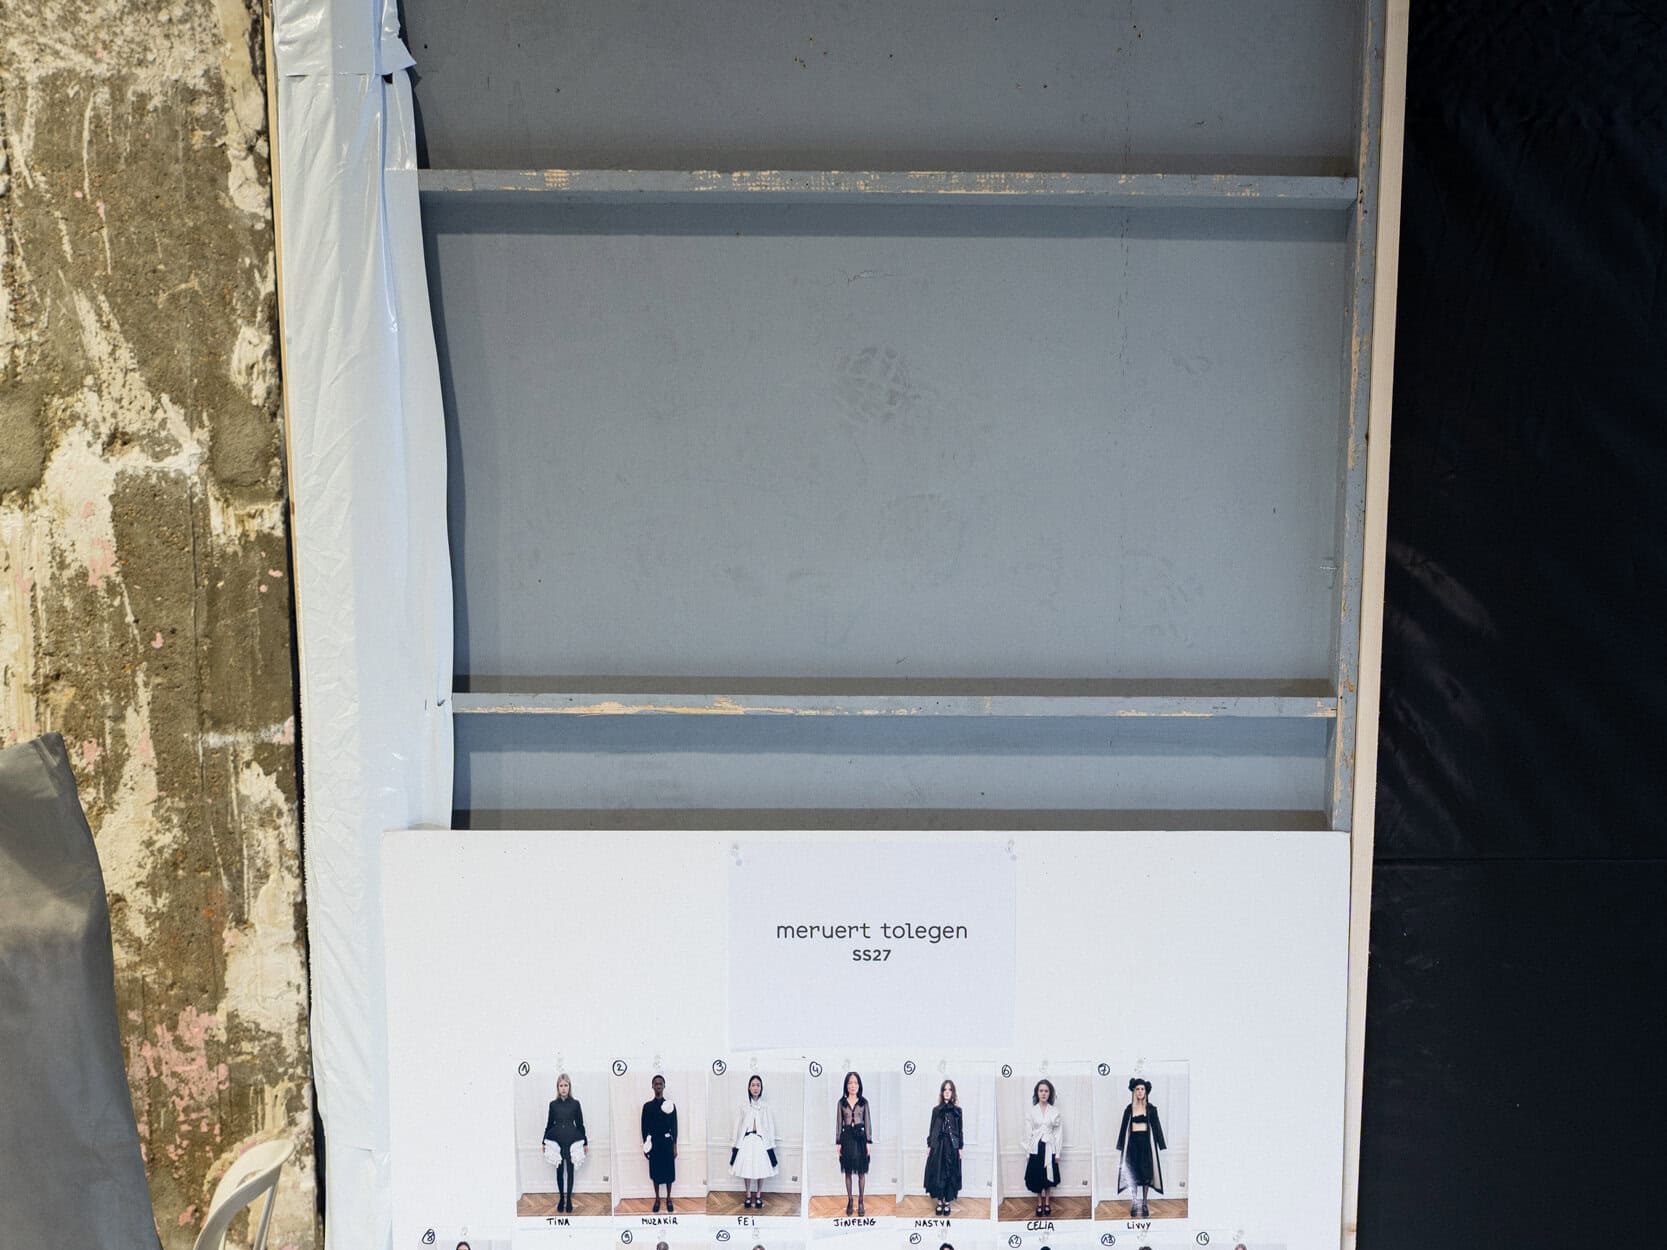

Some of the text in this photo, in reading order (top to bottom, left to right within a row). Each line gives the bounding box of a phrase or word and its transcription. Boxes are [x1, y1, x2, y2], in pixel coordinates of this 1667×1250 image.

[777, 923, 967, 943] meruert tolegen
[853, 950, 891, 961] SS27
